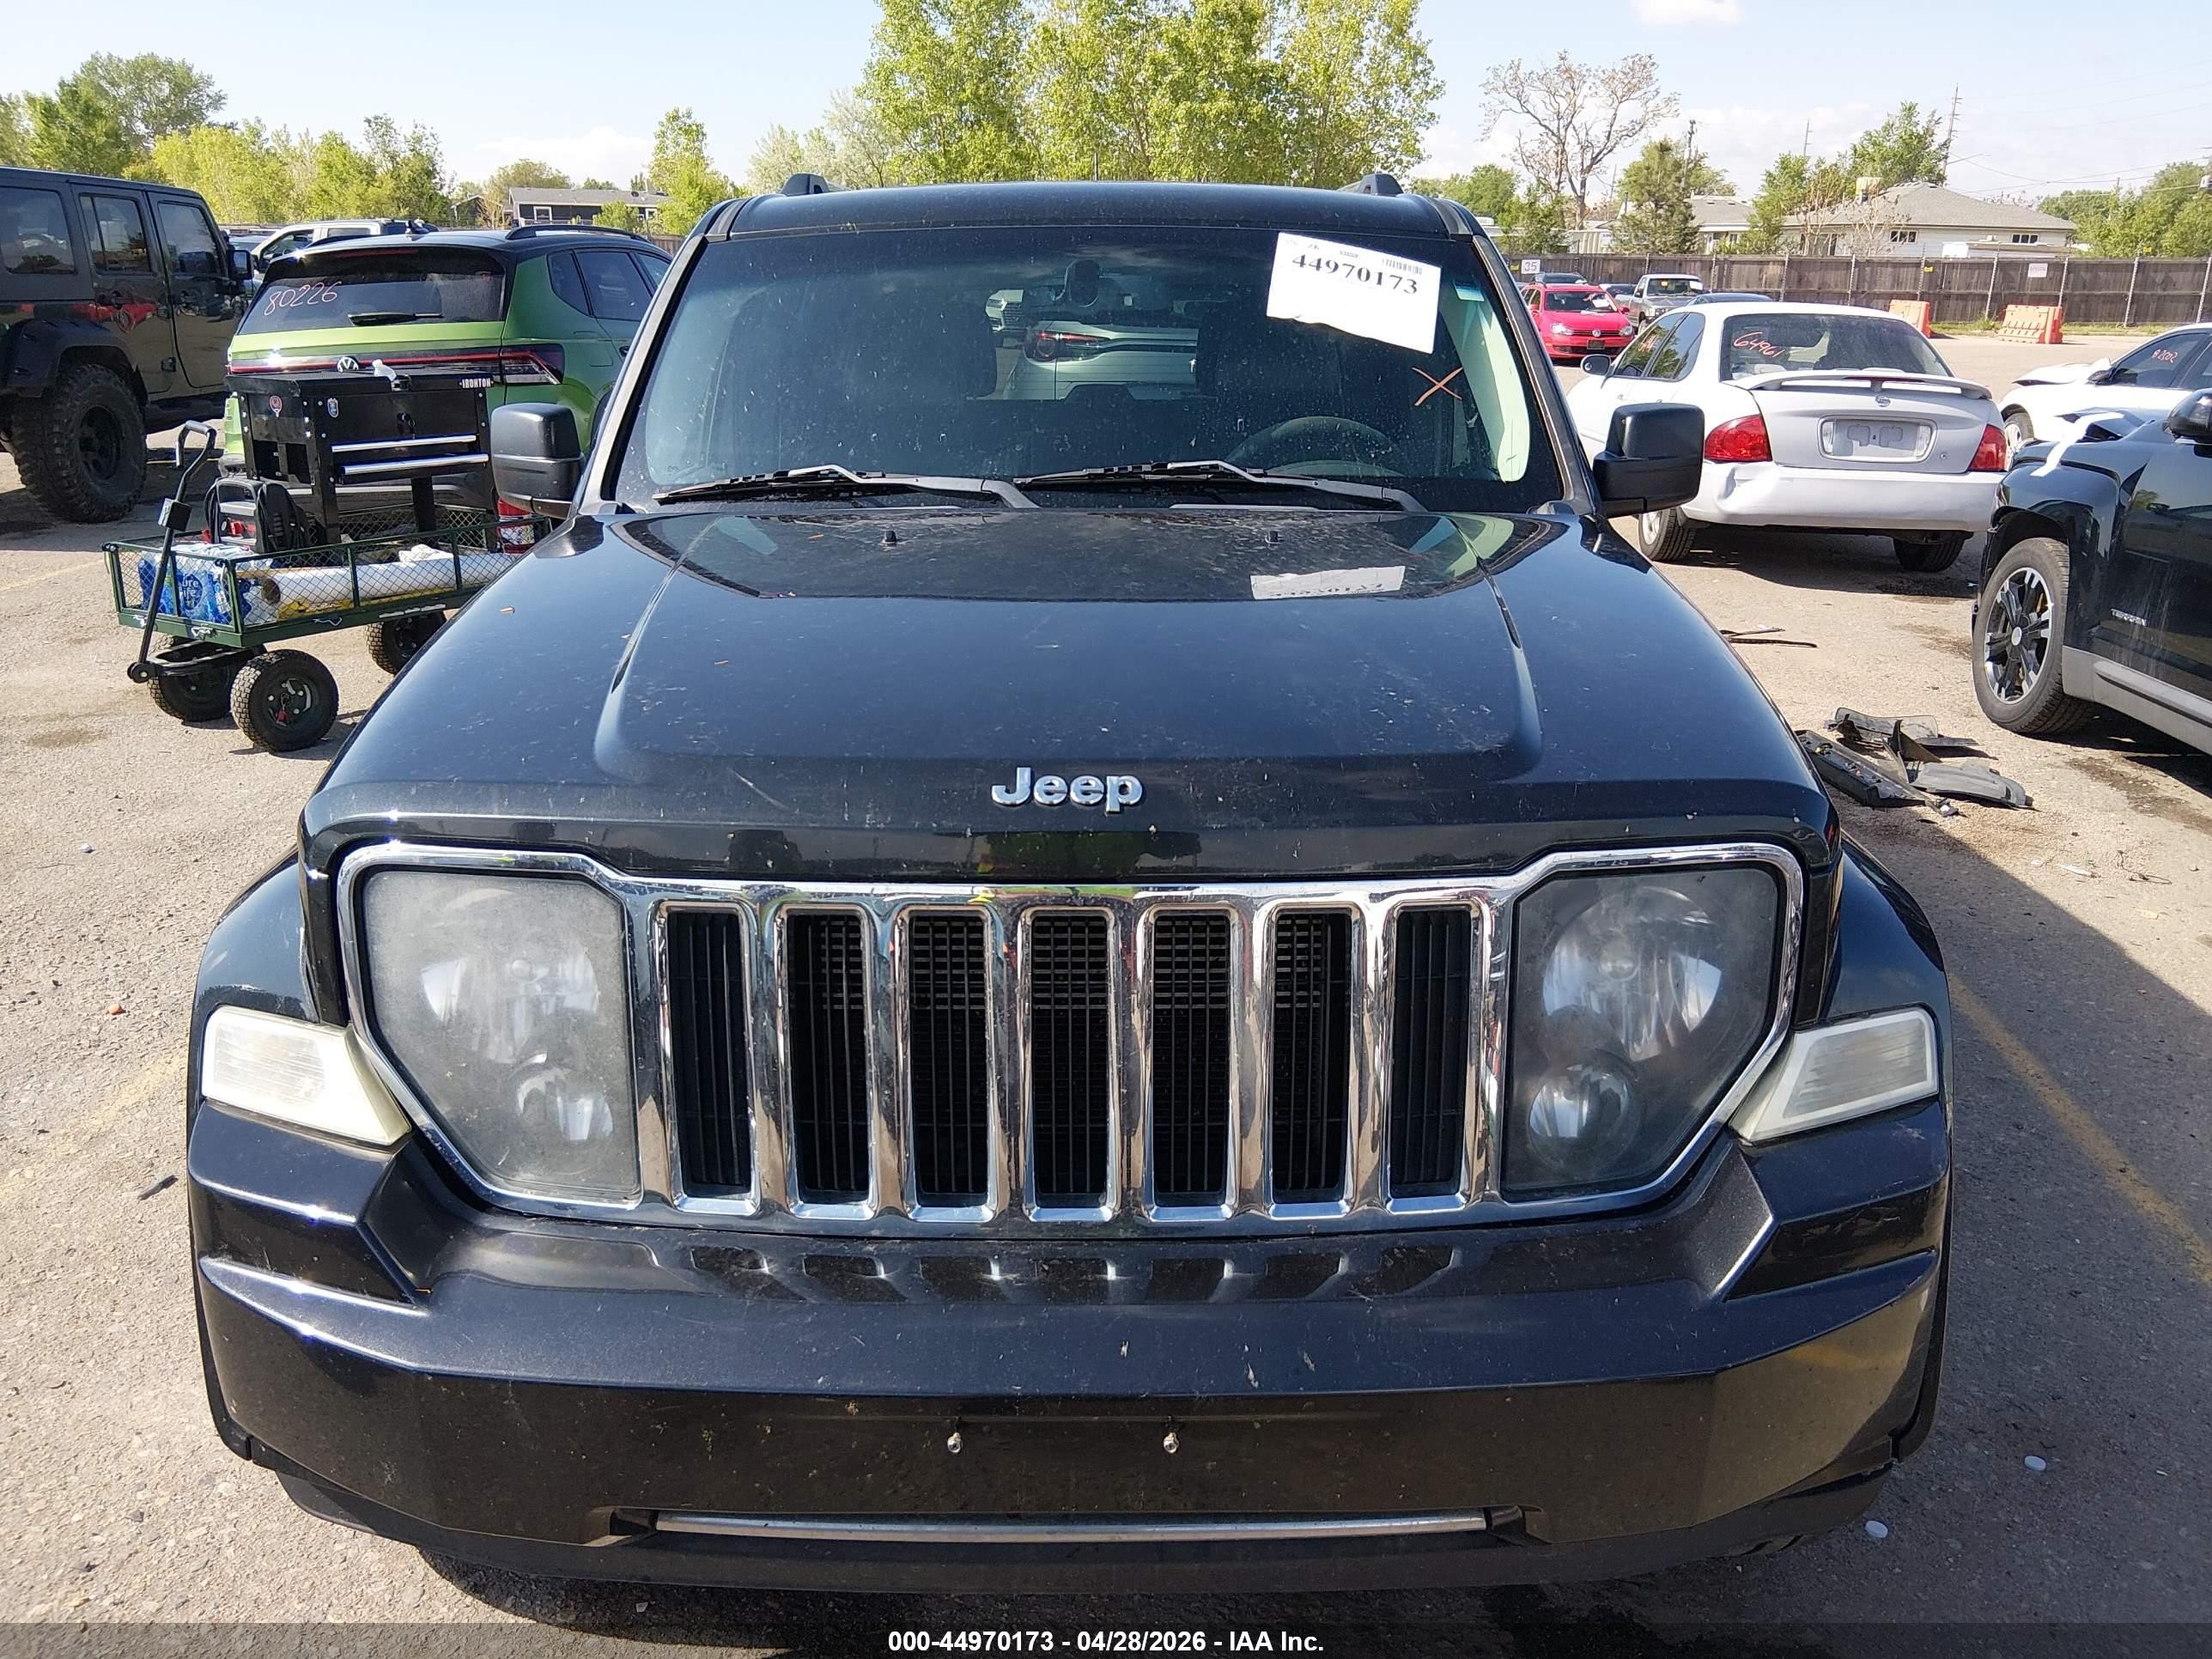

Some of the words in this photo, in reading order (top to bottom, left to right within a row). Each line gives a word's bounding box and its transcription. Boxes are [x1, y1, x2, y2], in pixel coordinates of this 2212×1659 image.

[1291, 253, 1419, 295] 44970173
[1524, 261, 1538, 272] 35
[264, 280, 343, 316] 80226
[461, 377, 491, 389] IRONTON
[991, 766, 1143, 813] Jeep
